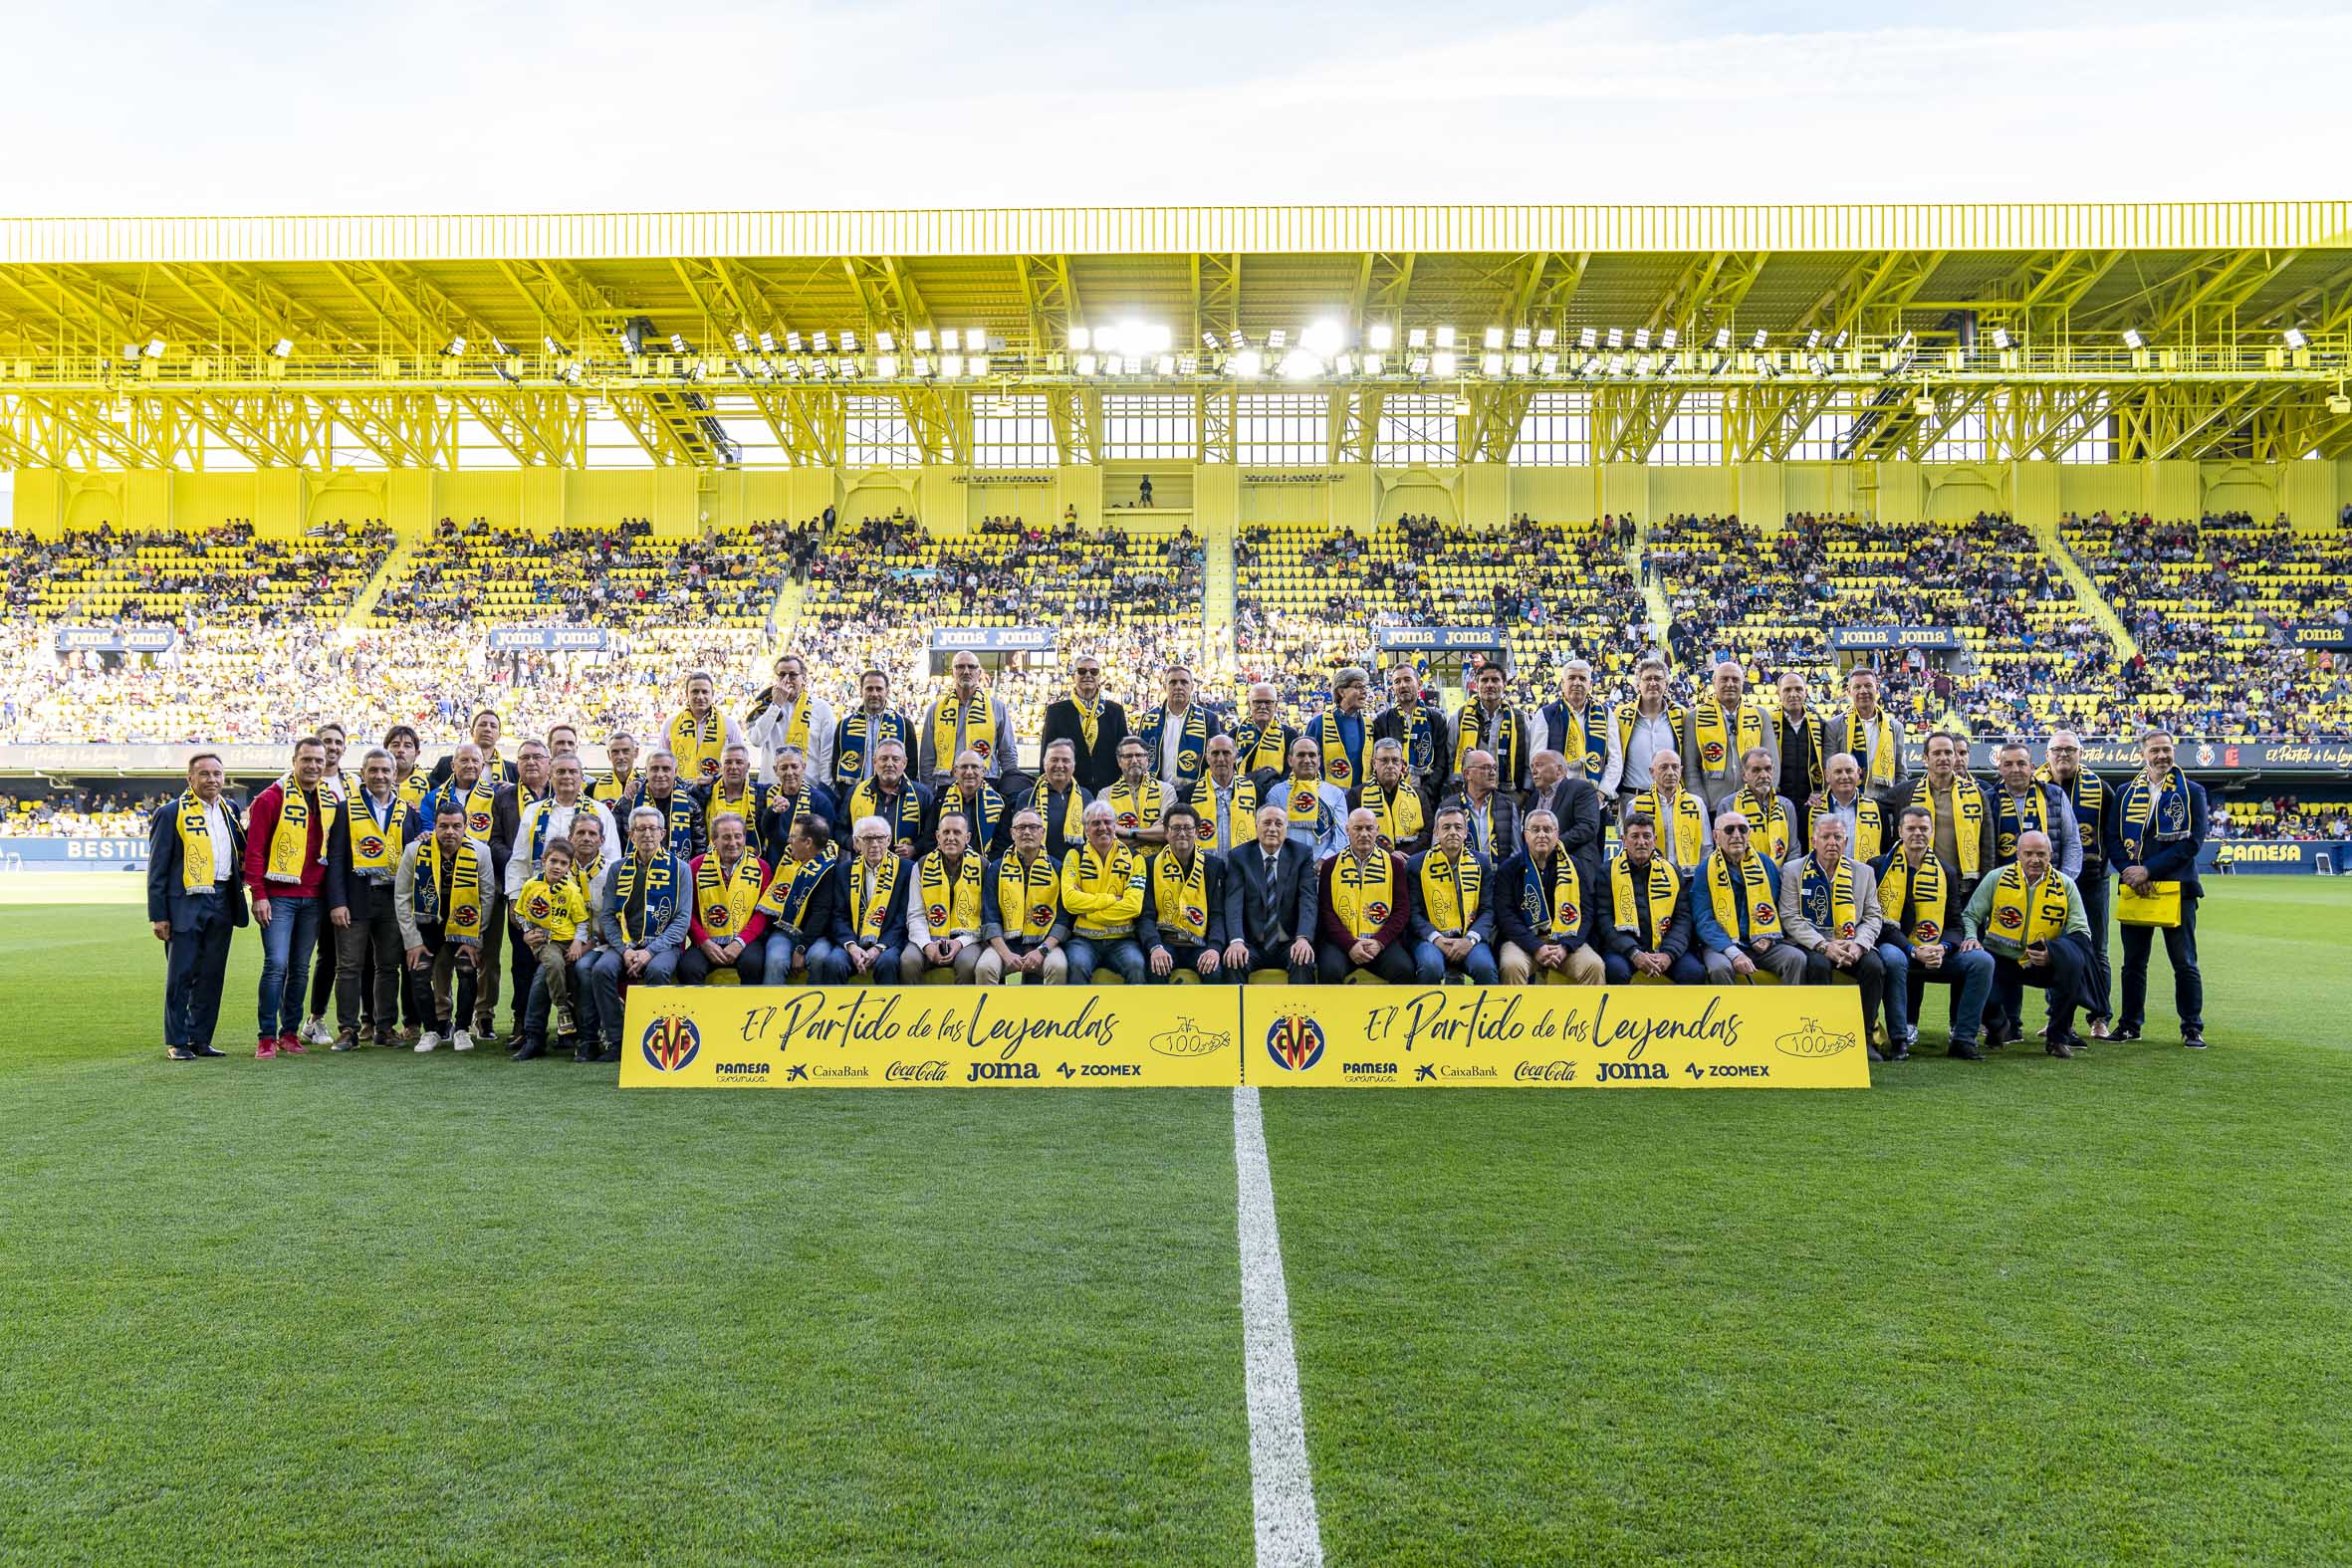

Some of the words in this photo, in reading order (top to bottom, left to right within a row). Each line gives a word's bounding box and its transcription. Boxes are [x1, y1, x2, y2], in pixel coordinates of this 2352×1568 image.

[741, 1007, 777, 1041] El
[780, 990, 901, 1051] Partido
[907, 1008, 932, 1037] de
[937, 1008, 966, 1041] las
[967, 993, 1120, 1059] Leyendas
[1364, 1007, 1399, 1041] El
[1404, 990, 1526, 1051] Partido
[1532, 1008, 1555, 1037] de
[1563, 1008, 1590, 1041] las
[1592, 994, 1744, 1060] Leyendas
[1166, 1035, 1201, 1051] 100
[1792, 1035, 1825, 1052] 100
[716, 1063, 770, 1074] PAMESA
[813, 1065, 869, 1077] CaixaBank
[1080, 1064, 1141, 1076] ZOOMEX
[1343, 1063, 1397, 1074] PAMESA
[1441, 1065, 1498, 1077] CaixaBank
[1709, 1065, 1769, 1077] ZOOMEX
